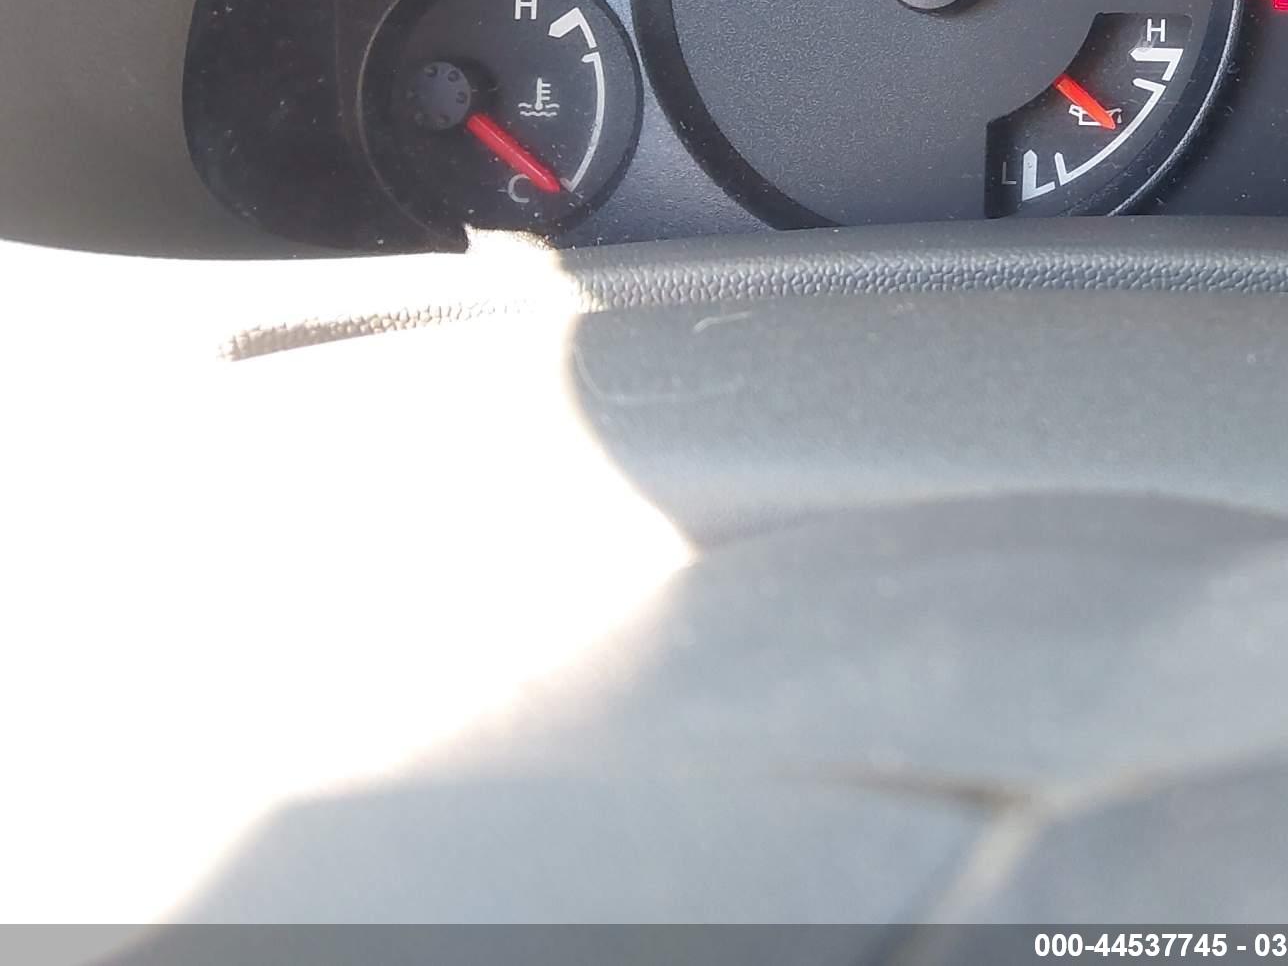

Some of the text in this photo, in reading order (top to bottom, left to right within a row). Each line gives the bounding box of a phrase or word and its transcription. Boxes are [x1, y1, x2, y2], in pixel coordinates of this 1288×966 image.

[1146, 18, 1166, 43] H
[1002, 160, 1018, 186] L
[507, 173, 532, 204] C
